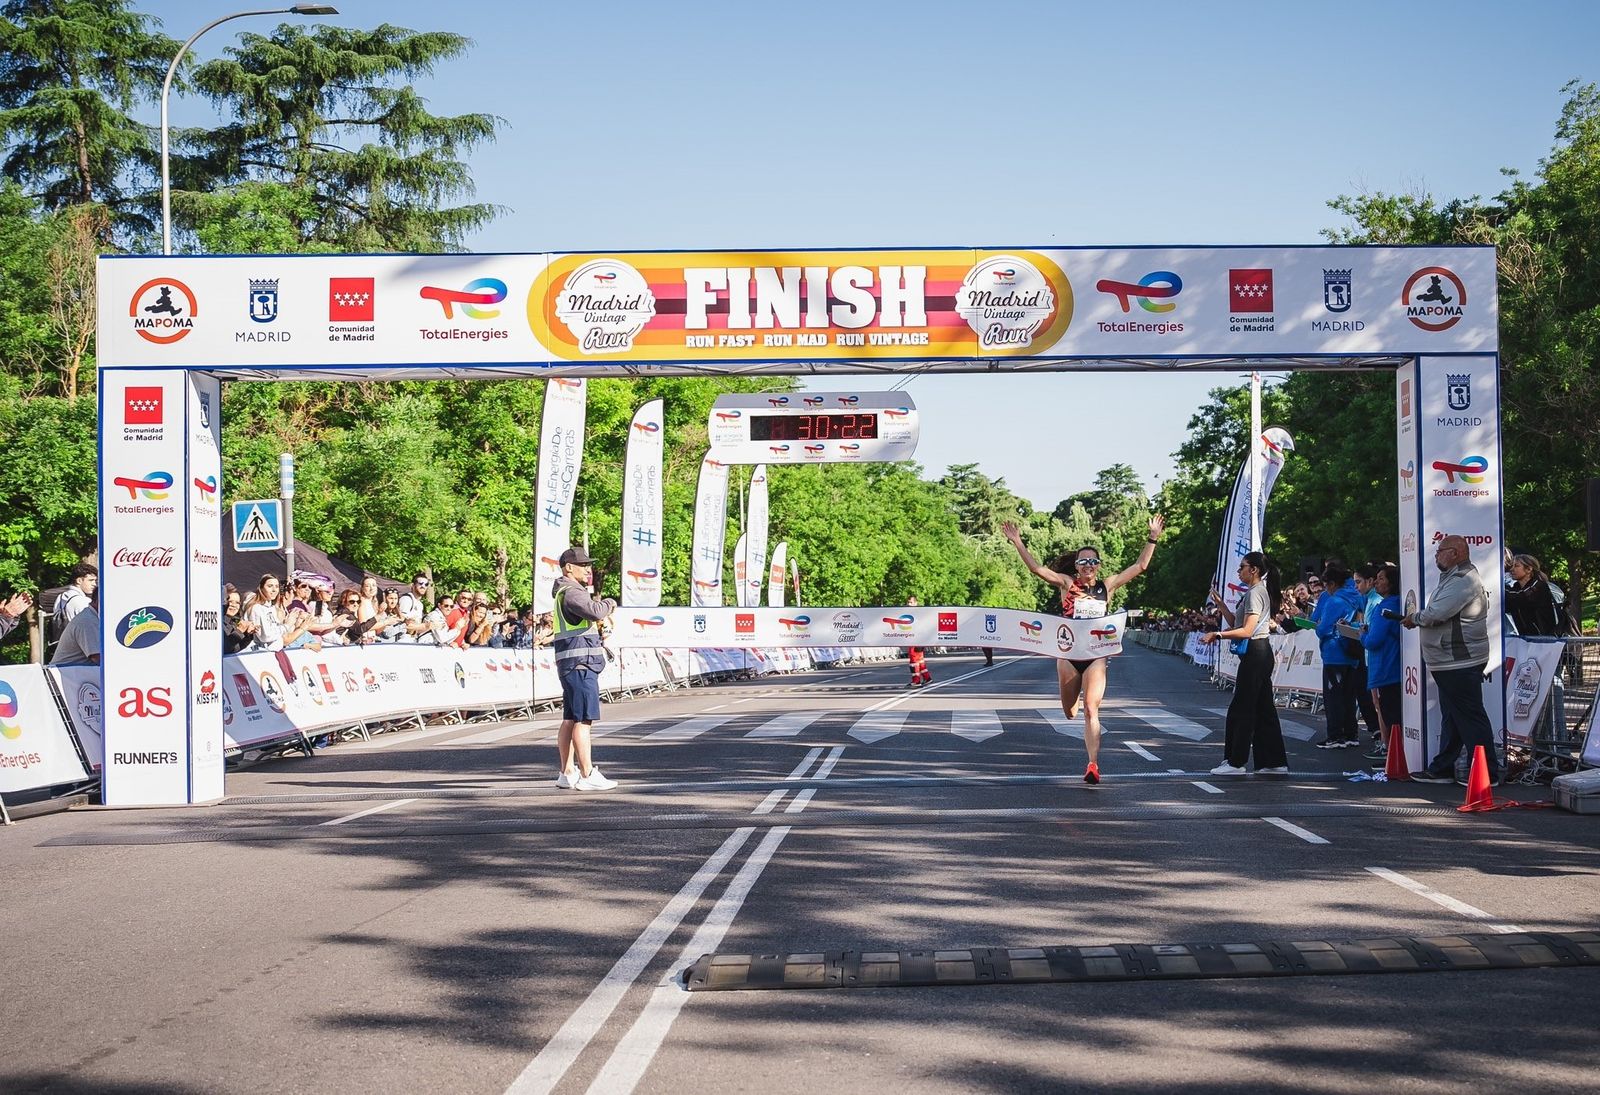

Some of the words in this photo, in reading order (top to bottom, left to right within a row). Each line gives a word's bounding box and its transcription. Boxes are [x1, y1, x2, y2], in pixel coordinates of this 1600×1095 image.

[568, 294, 642, 311] Madrid
[684, 265, 927, 329] FINISH
[968, 290, 1041, 307] Madrid
[584, 311, 626, 325] Vintage
[983, 308, 1026, 321] Vintage
[1407, 306, 1464, 317] MAPOMA
[134, 318, 194, 329] MAPOMA
[1097, 321, 1183, 334] TotalEnergies
[1230, 316, 1274, 326] Comunidad
[1312, 321, 1364, 331] MADRID
[236, 332, 291, 342] MADRID
[329, 326, 374, 335] Comunidad
[420, 328, 508, 341] TotalEnergies
[983, 322, 1029, 345] Run
[583, 327, 629, 349] Run
[686, 335, 715, 347] RUN
[718, 334, 756, 347] FAST
[763, 334, 793, 347] RUN
[796, 333, 828, 347] MAD
[836, 333, 865, 346] RUN
[868, 332, 929, 346] VINTAGE
[1438, 418, 1481, 426] MADRID
[1433, 488, 1490, 498] TotalEnergies
[114, 506, 174, 515] TotalEnergies
[195, 611, 217, 630] 226ERS
[1405, 666, 1418, 696] as
[118, 687, 172, 718] as
[197, 692, 211, 704] KISS
[0, 751, 41, 769] Energies
[114, 752, 177, 764] RUNNER'S
